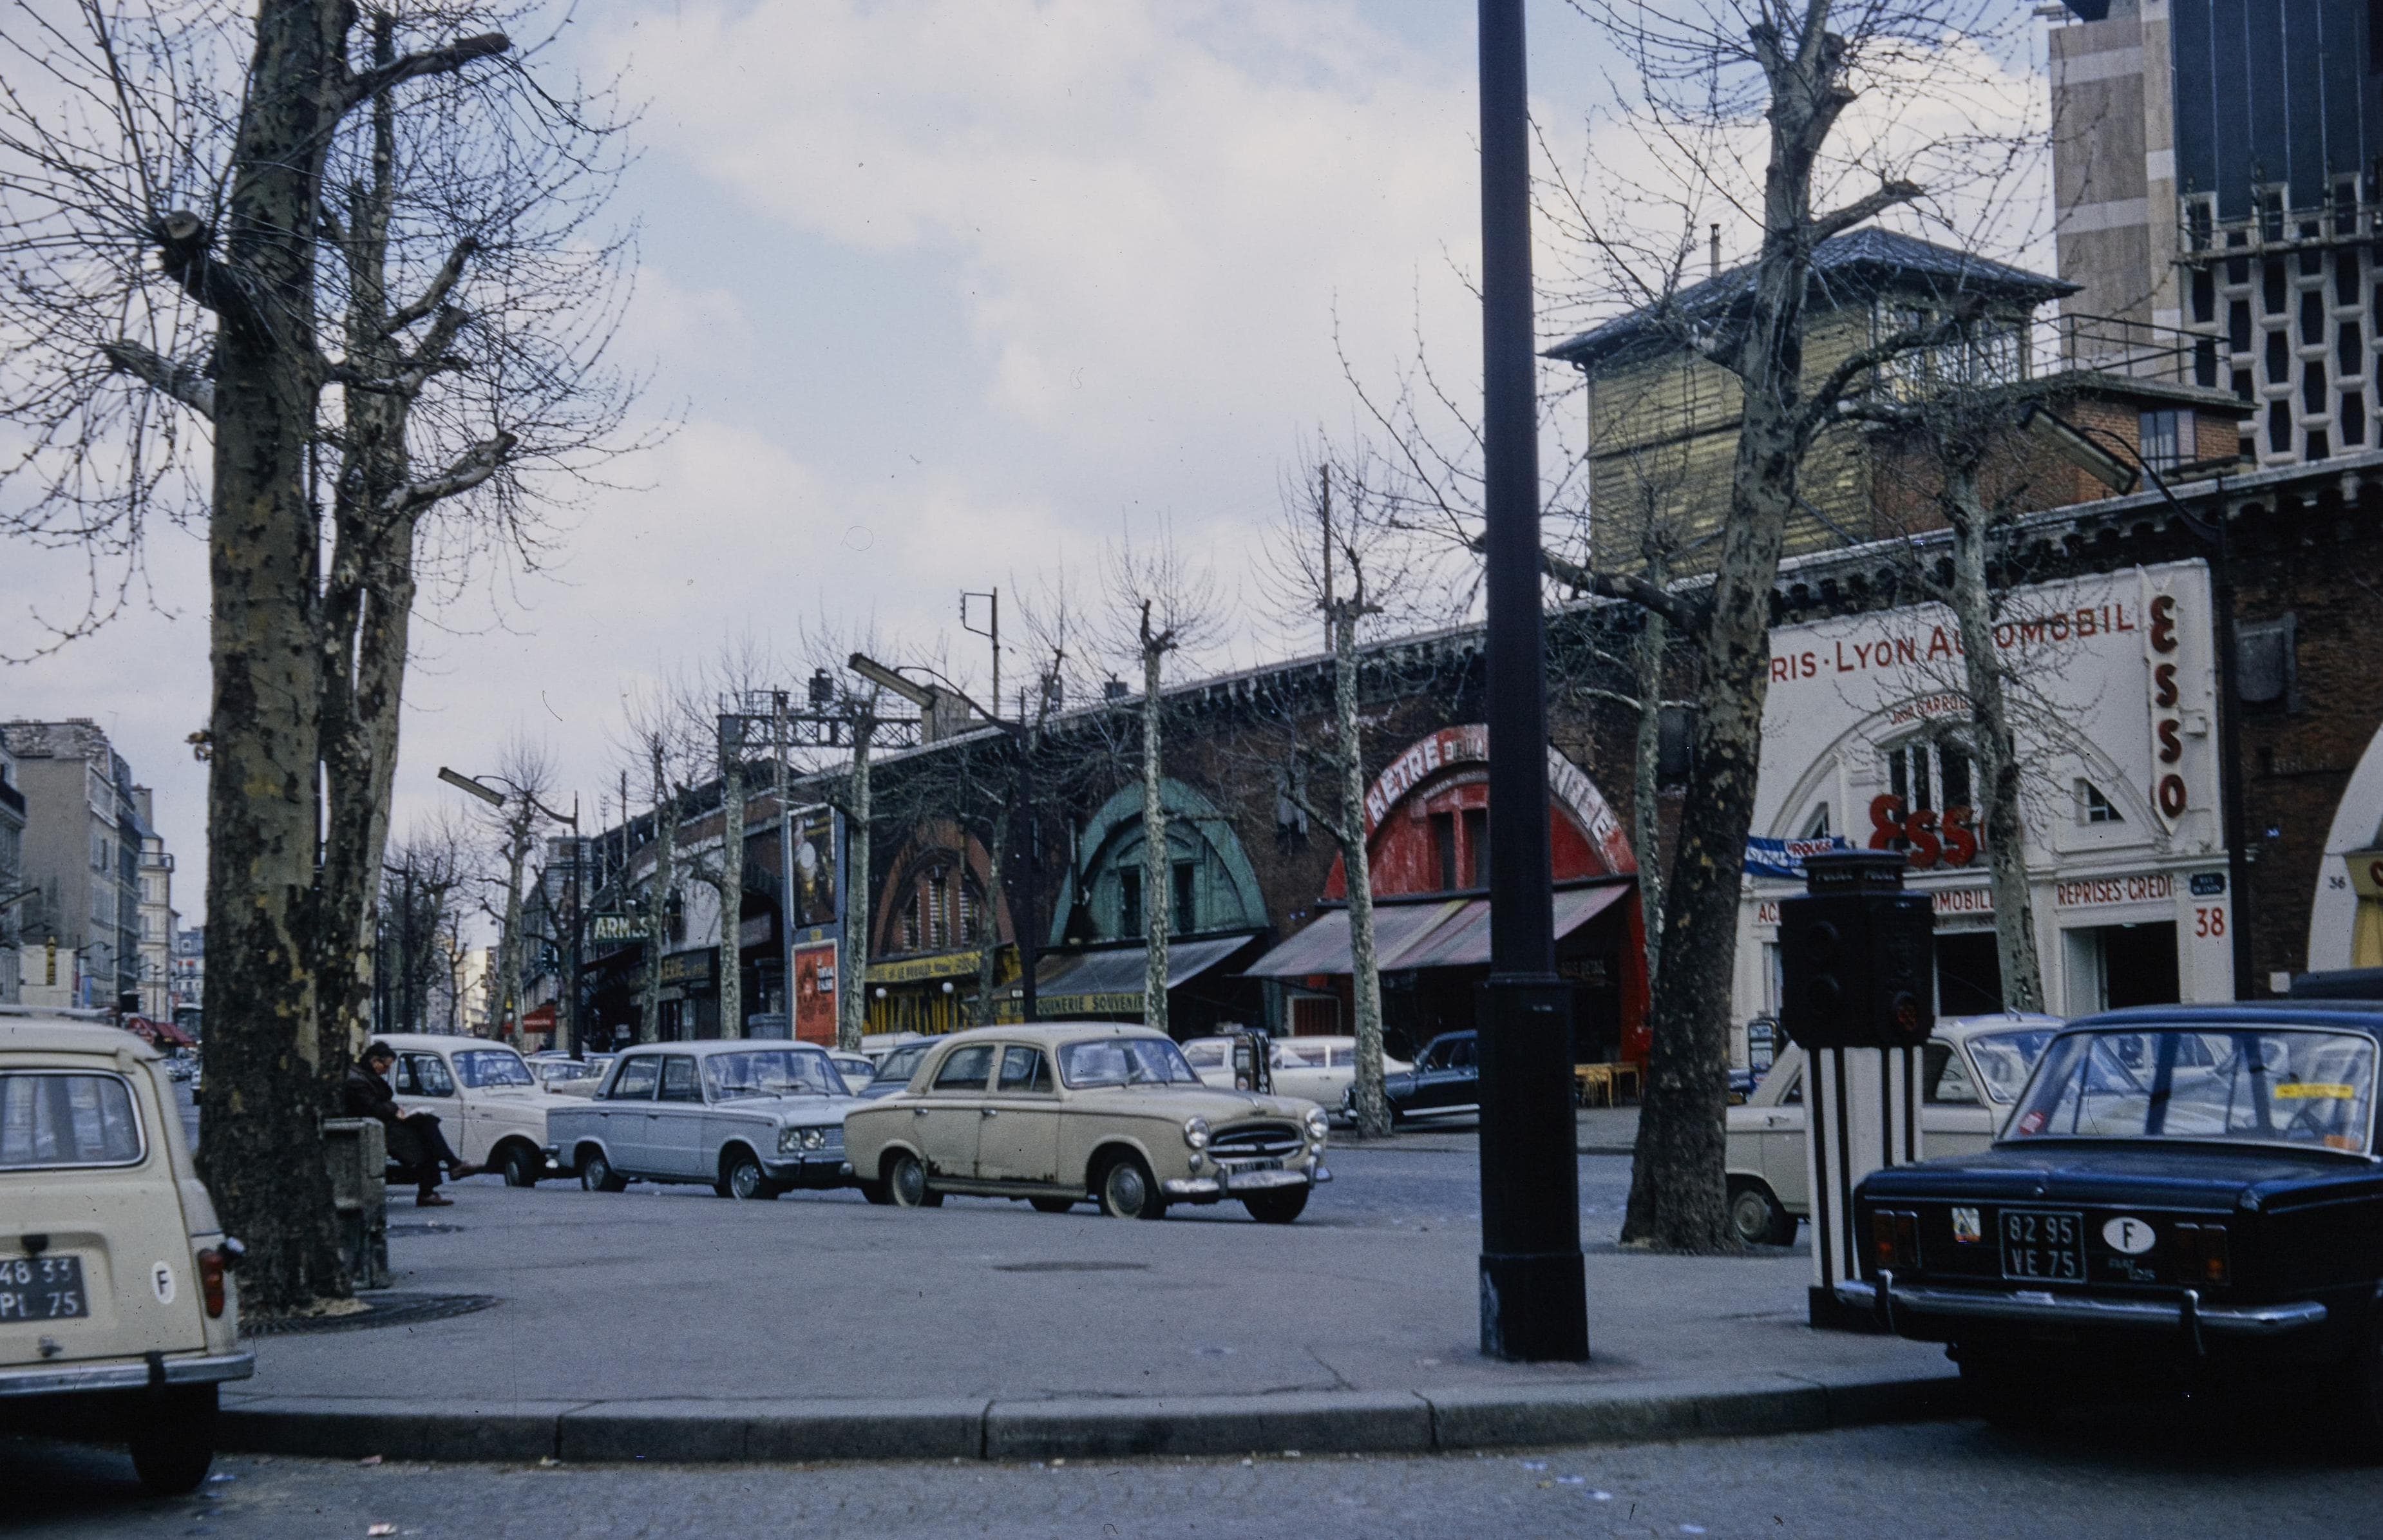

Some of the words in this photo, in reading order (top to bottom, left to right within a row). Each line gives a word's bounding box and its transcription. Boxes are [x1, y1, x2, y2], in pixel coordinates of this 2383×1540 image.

[1771, 652, 1817, 683] RIS
[1927, 604, 2134, 661] AUOMOBIL
[1932, 889, 1995, 911] OMOBIL
[2127, 875, 2173, 900] CREDI
[2195, 907, 2225, 938] 38
[2009, 1215, 2037, 1243] 82
[2045, 1216, 2074, 1244] 95
[2122, 1221, 2136, 1249] F
[0, 1260, 32, 1286] 48
[41, 1258, 73, 1283] 33
[2011, 1248, 2039, 1276] VE
[2048, 1250, 2076, 1278] 75
[47, 1290, 79, 1316] 75
